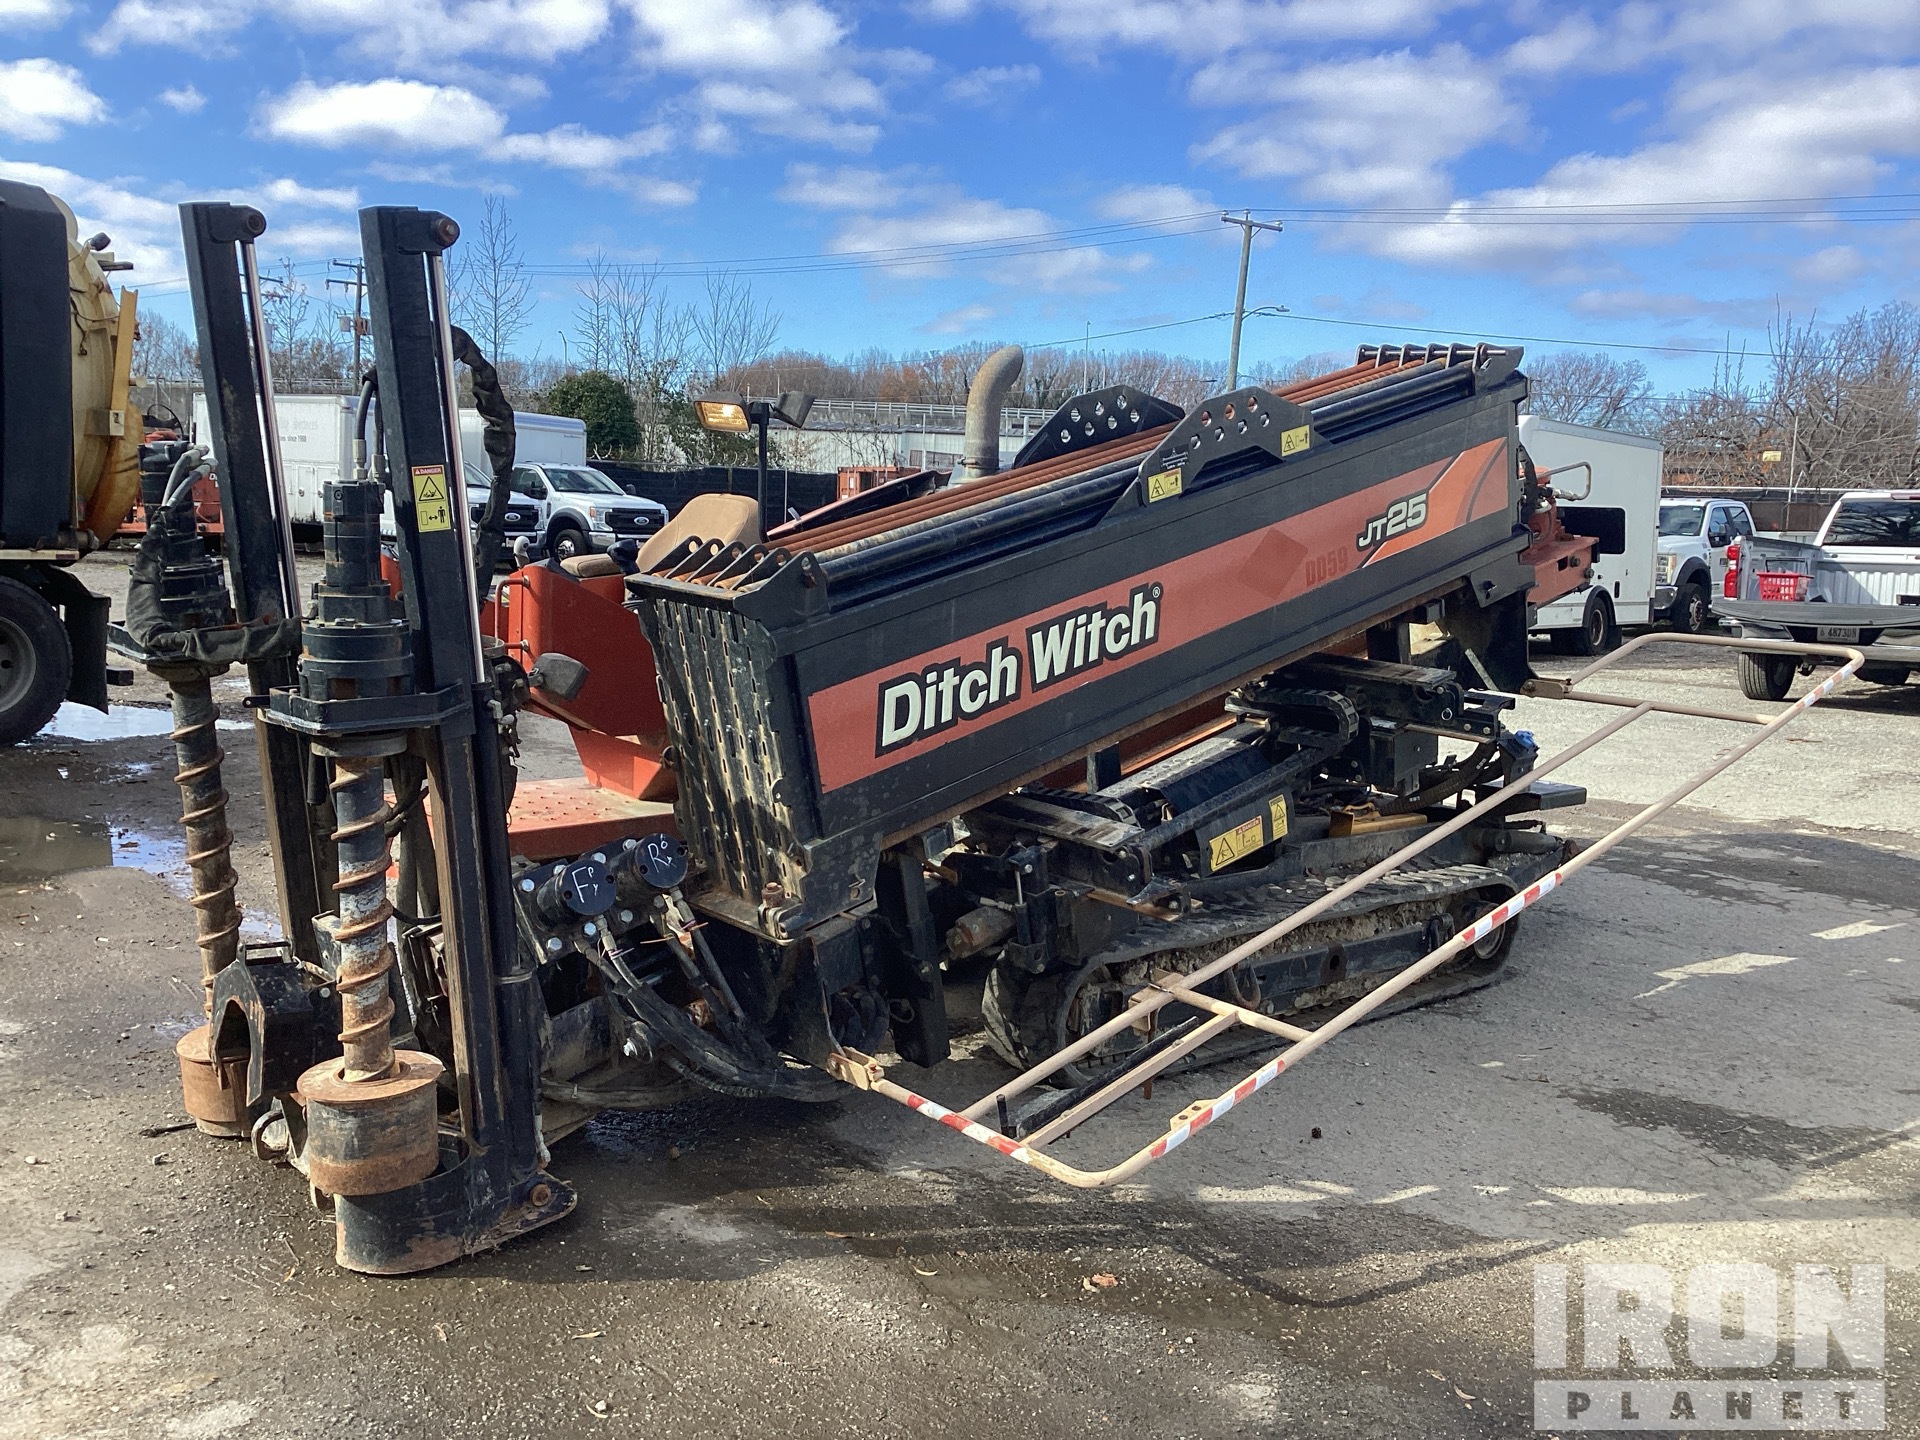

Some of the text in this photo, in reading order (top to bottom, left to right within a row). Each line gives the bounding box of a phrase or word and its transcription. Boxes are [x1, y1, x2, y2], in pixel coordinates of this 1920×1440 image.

[419, 467, 442, 475] DANGER
[1358, 492, 1427, 548] JT25
[881, 645, 1019, 748] Ditch
